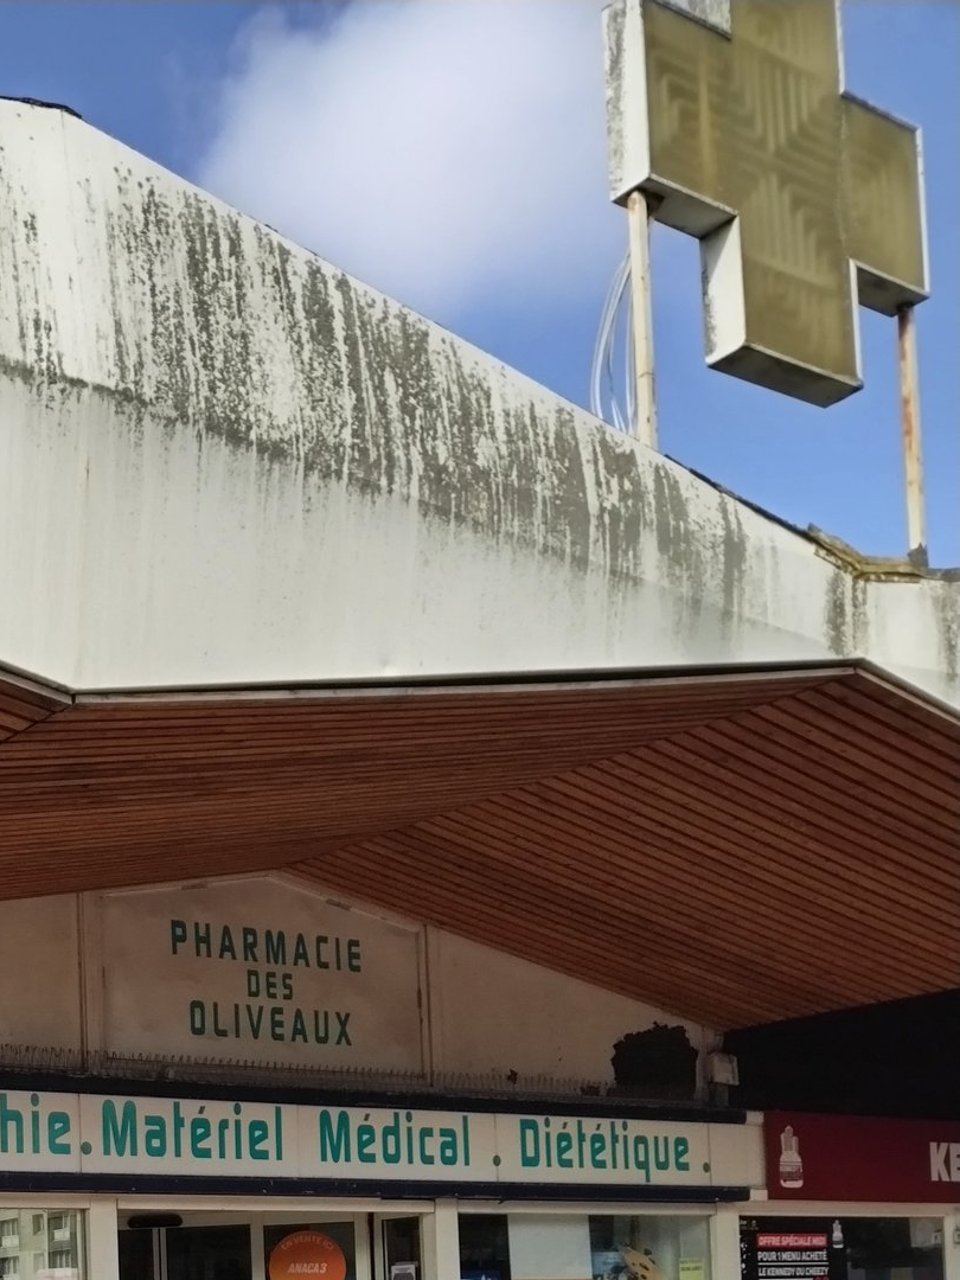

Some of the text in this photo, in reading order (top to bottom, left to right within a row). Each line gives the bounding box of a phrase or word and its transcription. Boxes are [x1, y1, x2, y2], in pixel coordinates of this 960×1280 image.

[170, 919, 362, 973] PHARMACIE
[247, 969, 294, 1001] DES
[190, 999, 353, 1047] OLIVEAUX
[102, 1099, 283, 1161] Matériel
[320, 1109, 470, 1167] Médical
